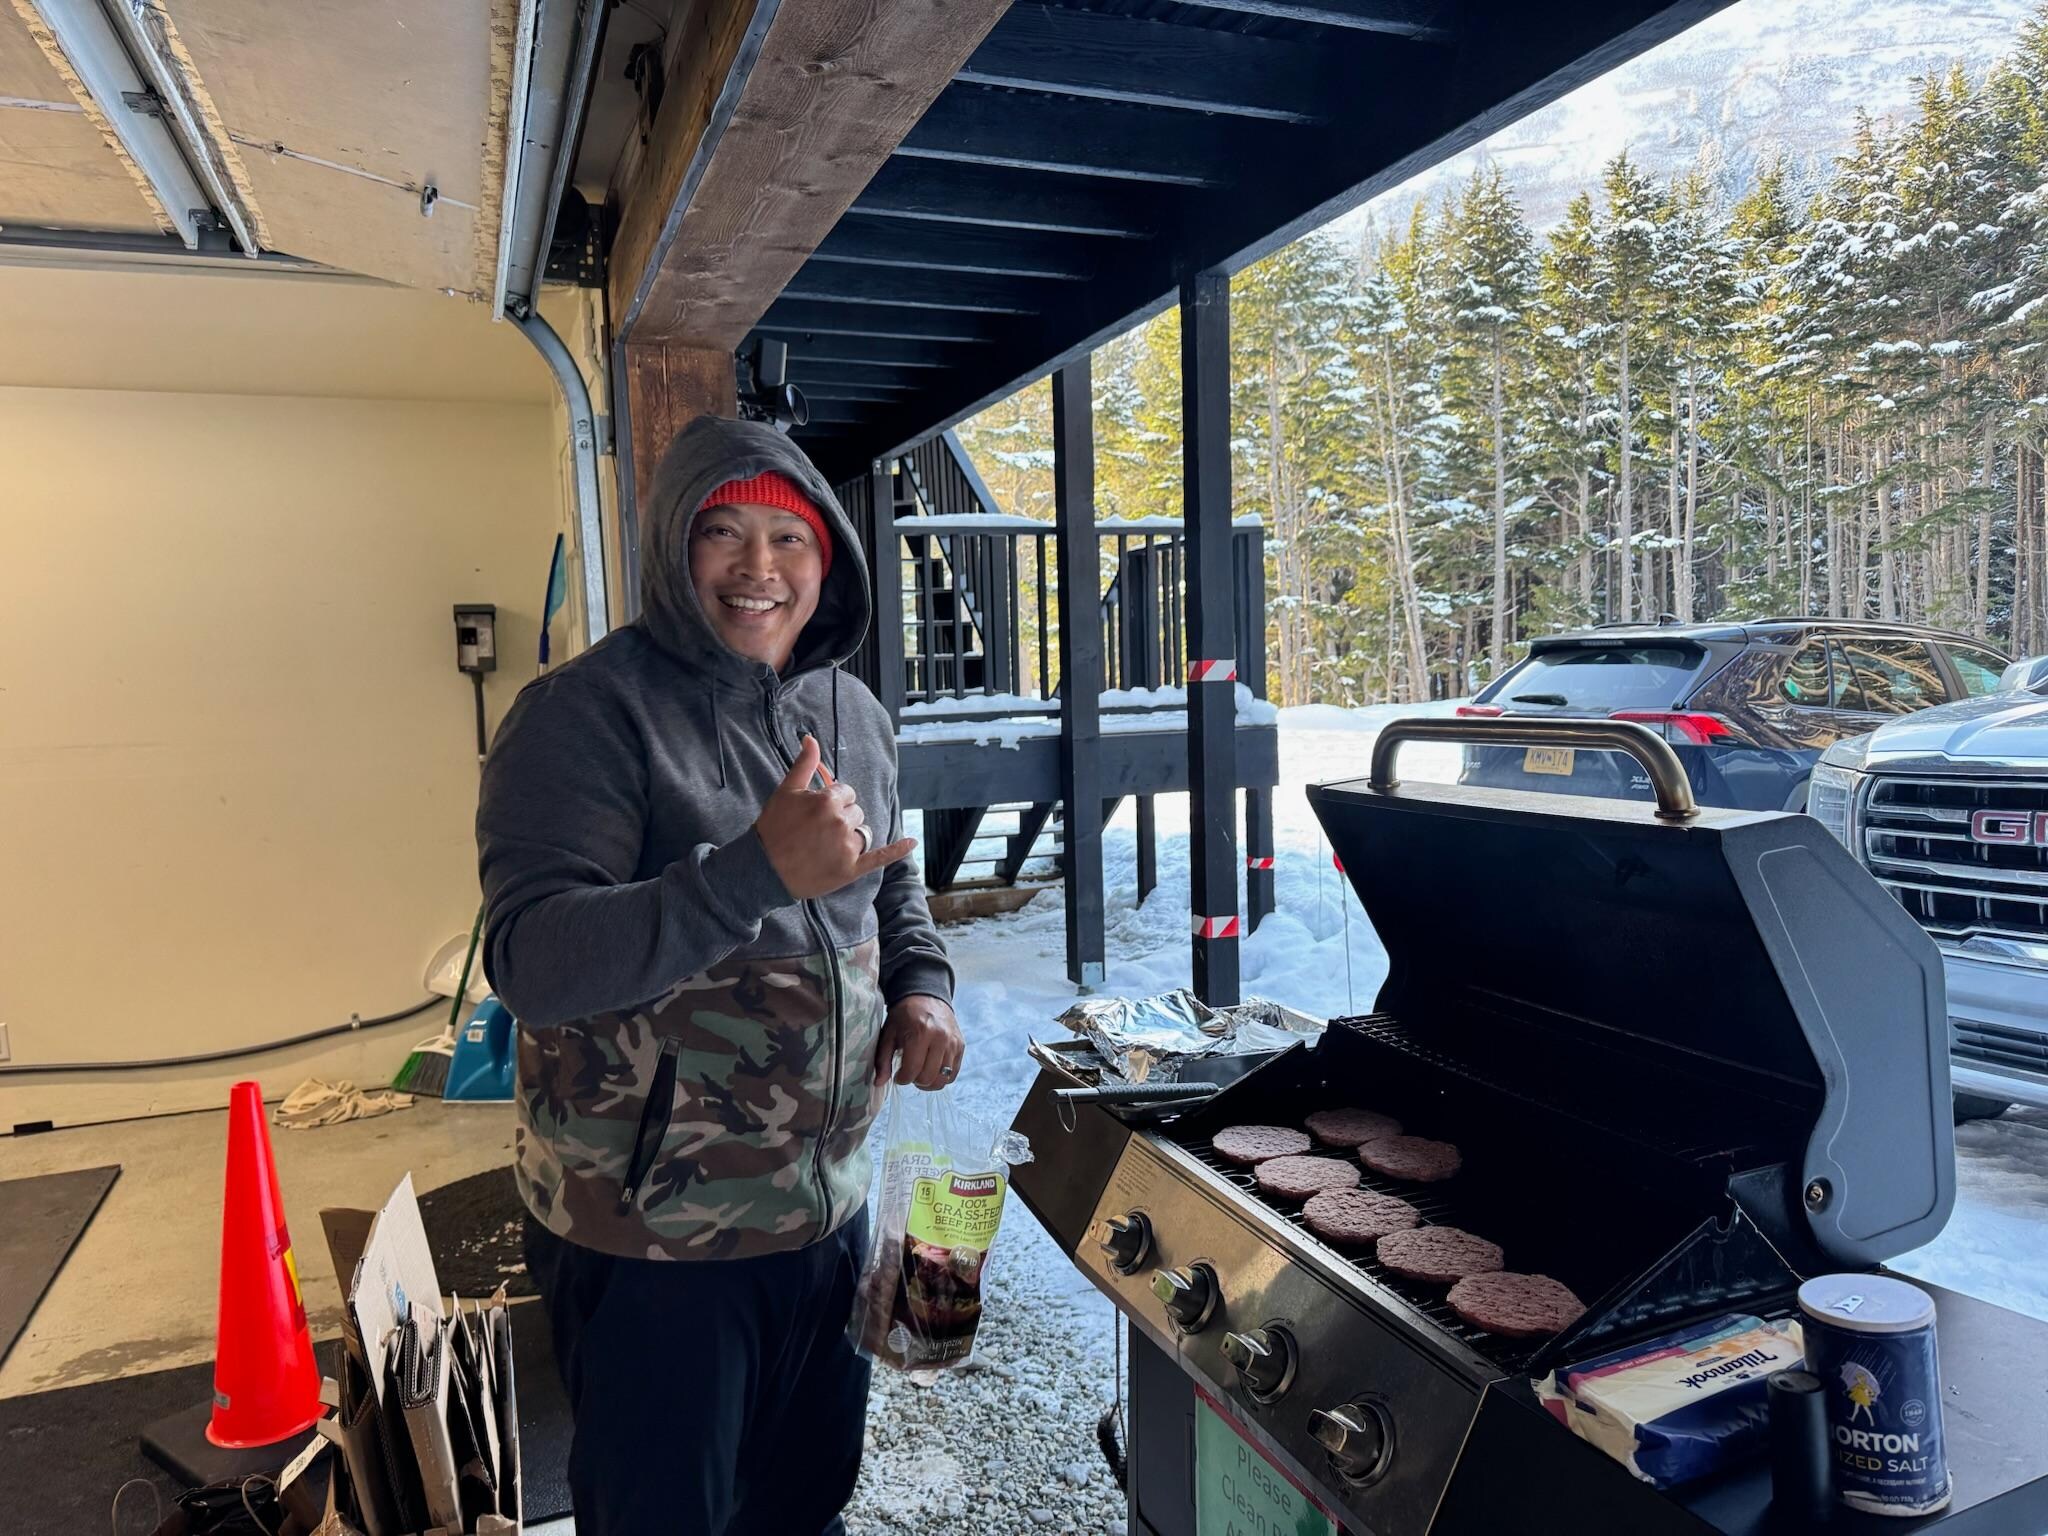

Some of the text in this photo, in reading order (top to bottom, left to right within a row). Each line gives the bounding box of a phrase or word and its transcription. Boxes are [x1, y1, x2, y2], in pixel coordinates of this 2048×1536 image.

[1971, 809, 2048, 847] G
[922, 1187, 931, 1196] 15
[953, 1177, 996, 1190] KIRKLAND
[933, 1202, 1001, 1220] GRASS-FED
[960, 1199, 988, 1209] 100%
[935, 1215, 963, 1228] BEEF
[964, 1218, 998, 1231] PATTIES
[1677, 1348, 1779, 1389] Tillamook
[1831, 1425, 1920, 1454] ORTON
[1837, 1449, 1929, 1473] IZED SALT
[1237, 1444, 1292, 1516] Please
[1222, 1474, 1267, 1536] Clean
